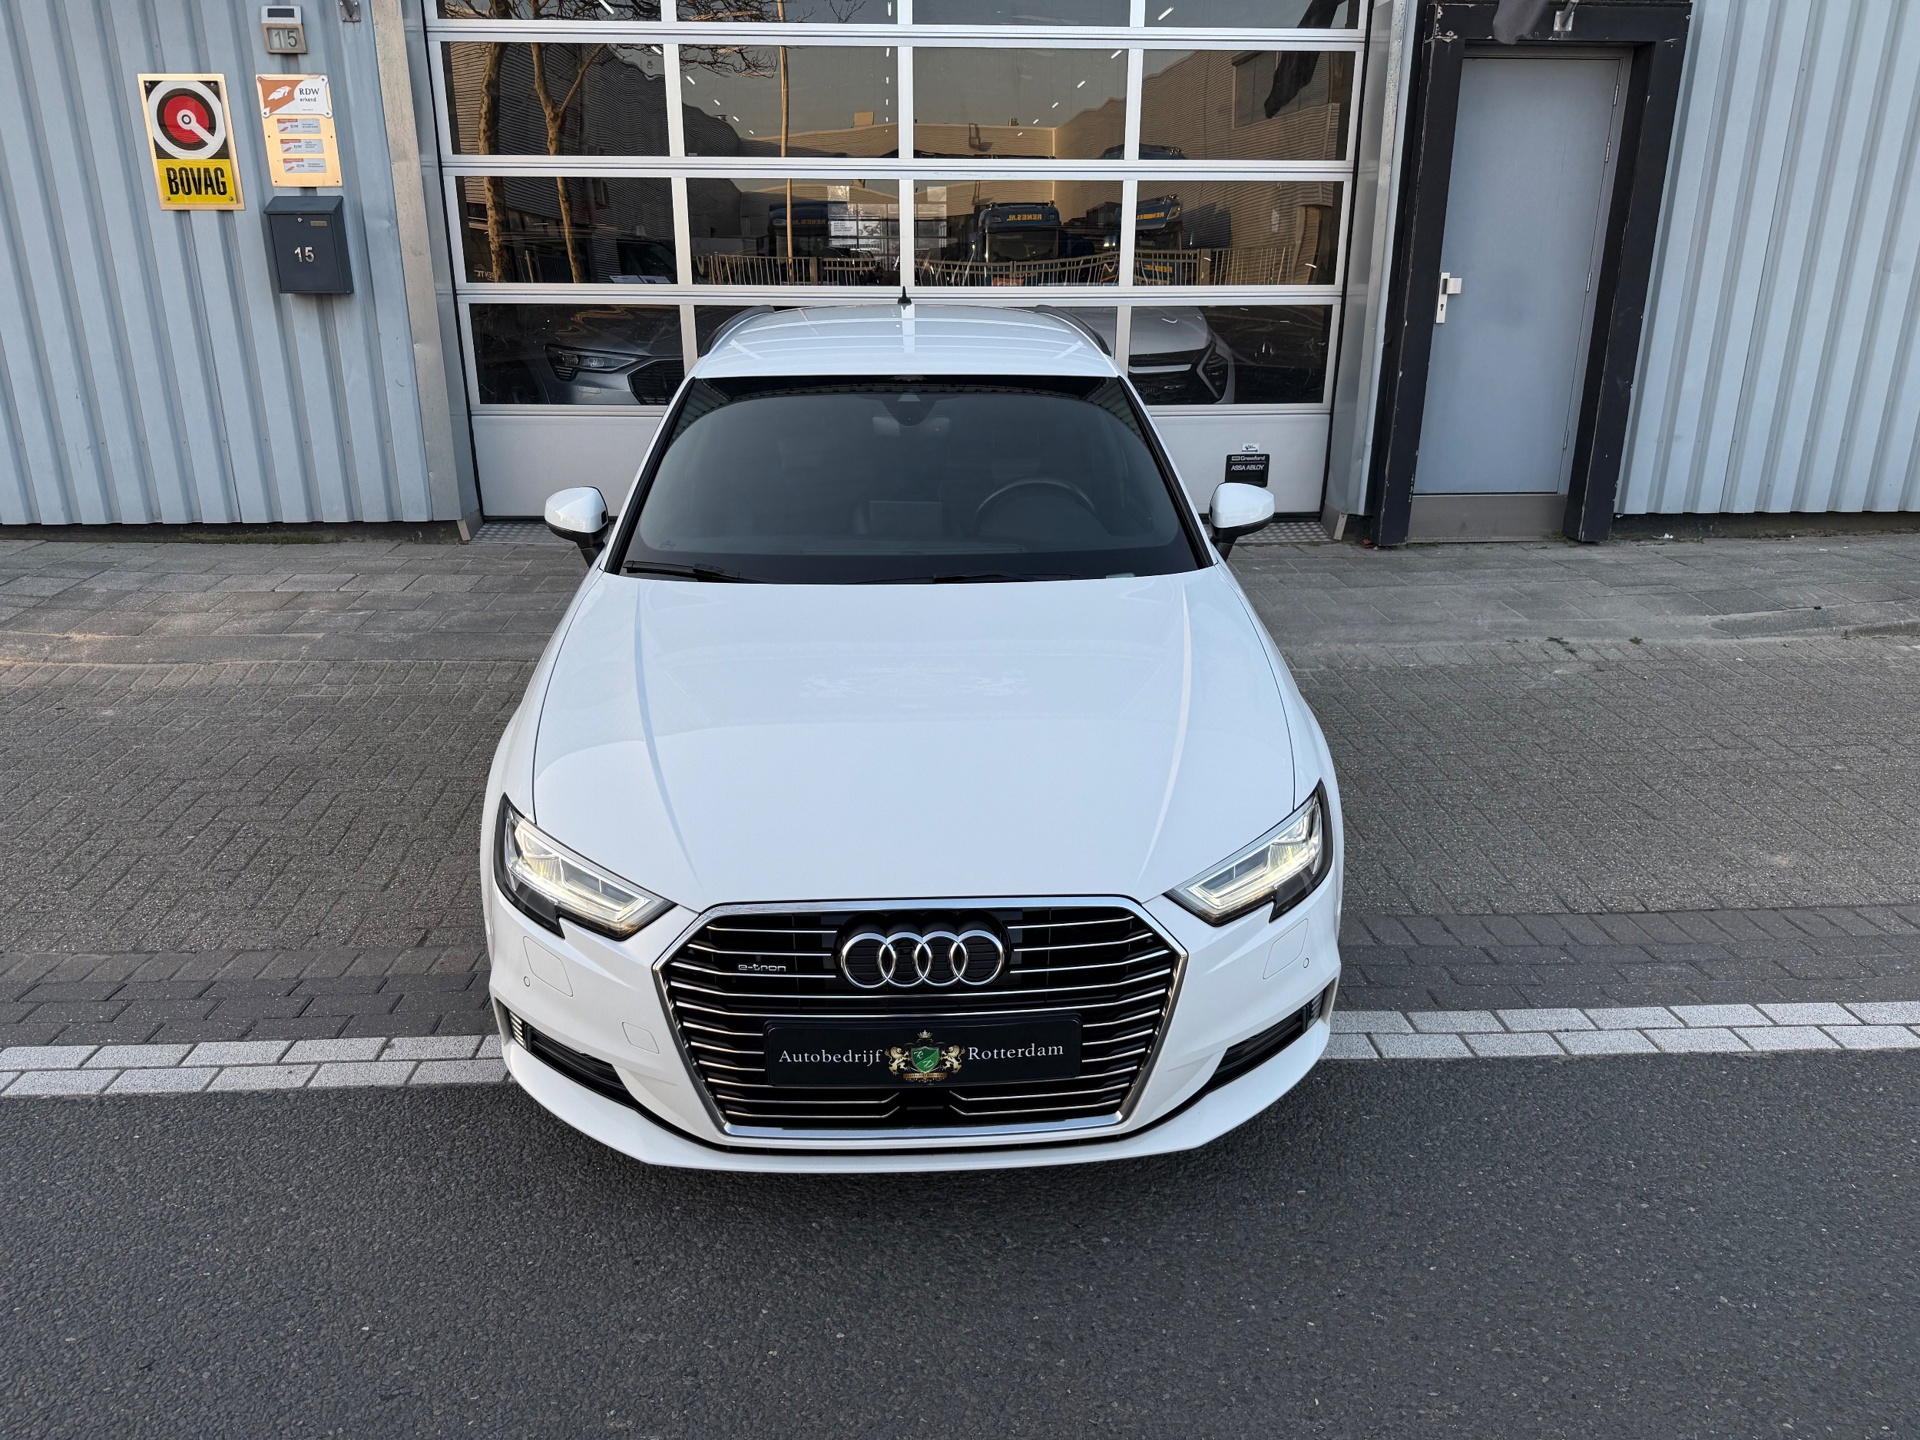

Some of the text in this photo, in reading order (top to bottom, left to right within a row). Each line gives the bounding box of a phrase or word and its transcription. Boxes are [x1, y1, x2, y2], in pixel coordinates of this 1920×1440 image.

[274, 30, 298, 48] 15
[299, 87, 320, 96] RDW
[165, 167, 228, 195] BOVAG
[294, 246, 315, 263] 15
[738, 963, 787, 972] e-tron
[778, 1043, 1064, 1067] Autobedrijf Rotterdam
